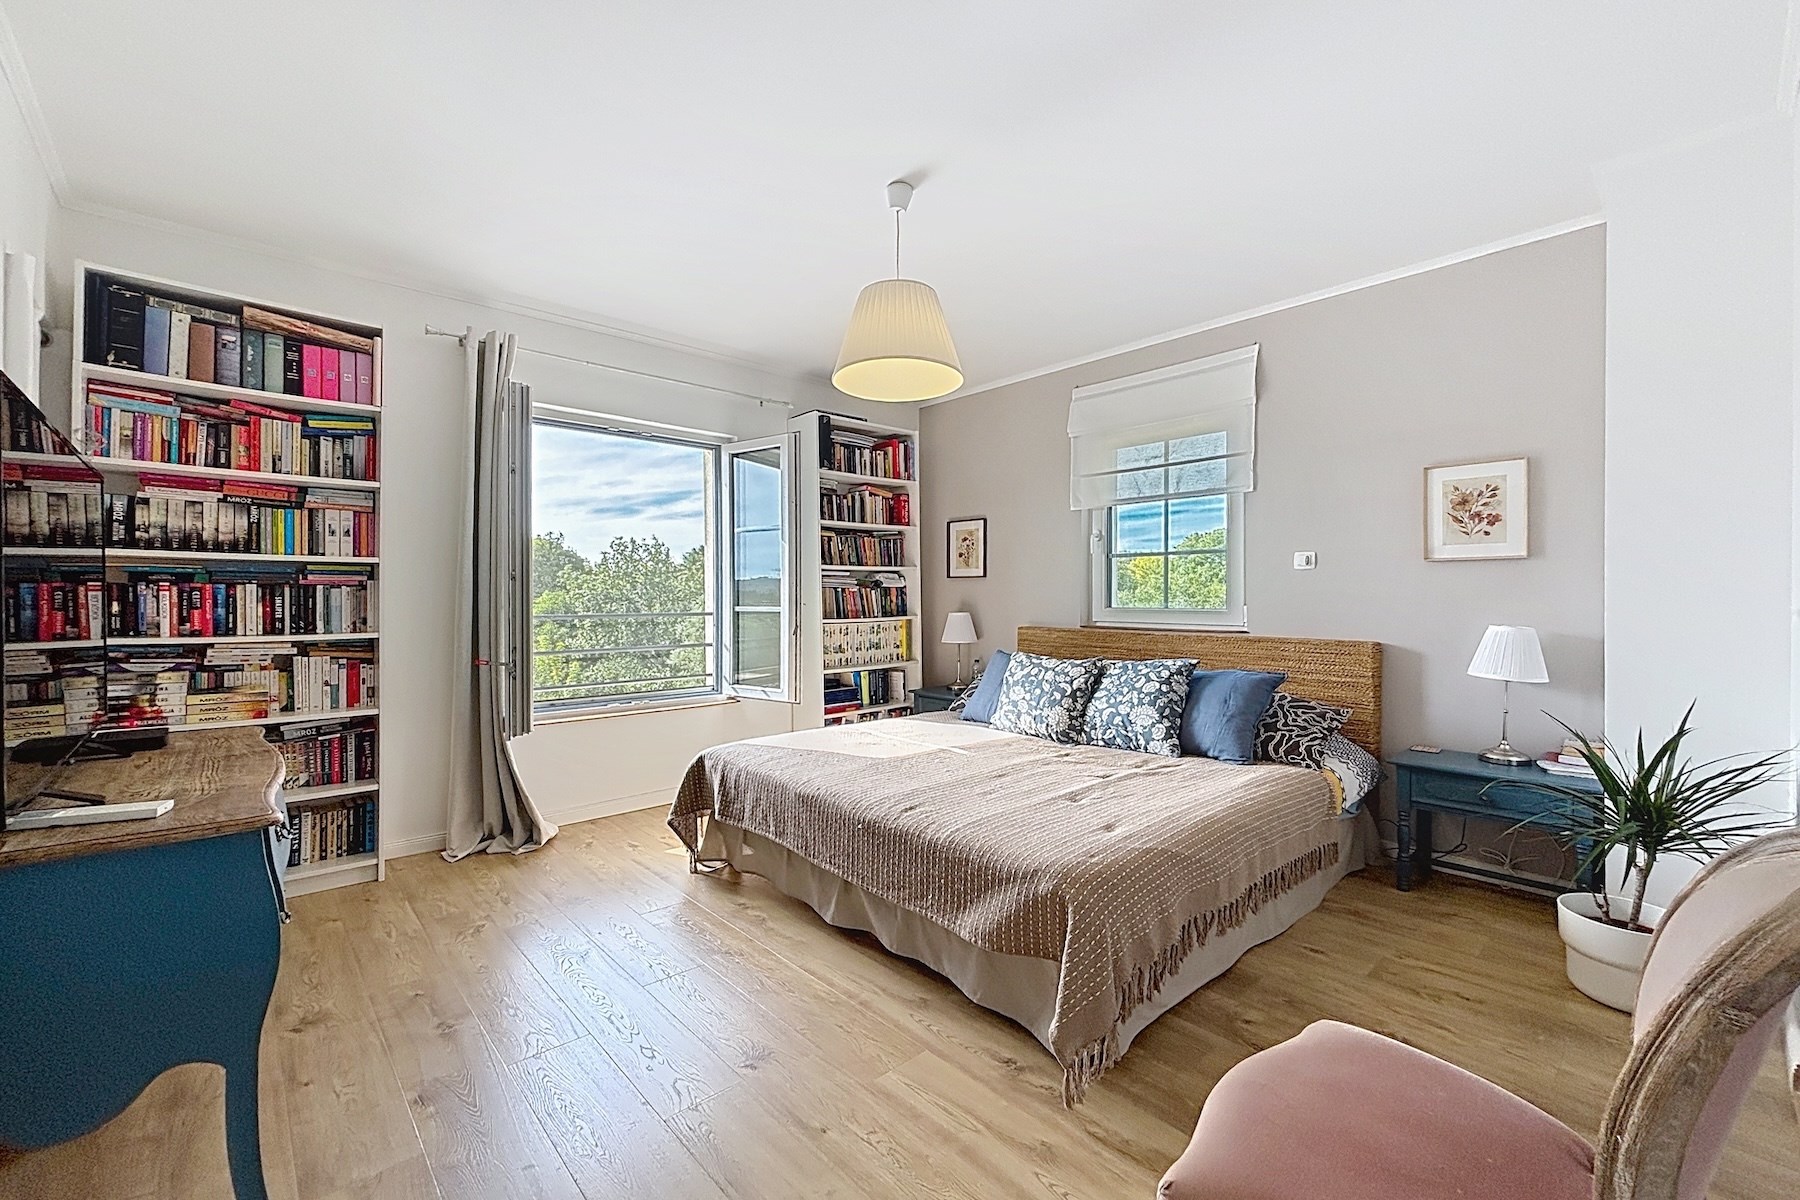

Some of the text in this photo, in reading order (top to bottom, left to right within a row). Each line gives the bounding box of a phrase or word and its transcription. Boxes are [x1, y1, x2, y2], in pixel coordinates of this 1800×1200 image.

[247, 488, 288, 499] GUCCI
[227, 496, 252, 504] MRÓZ
[274, 596, 283, 618] SNAJPER
